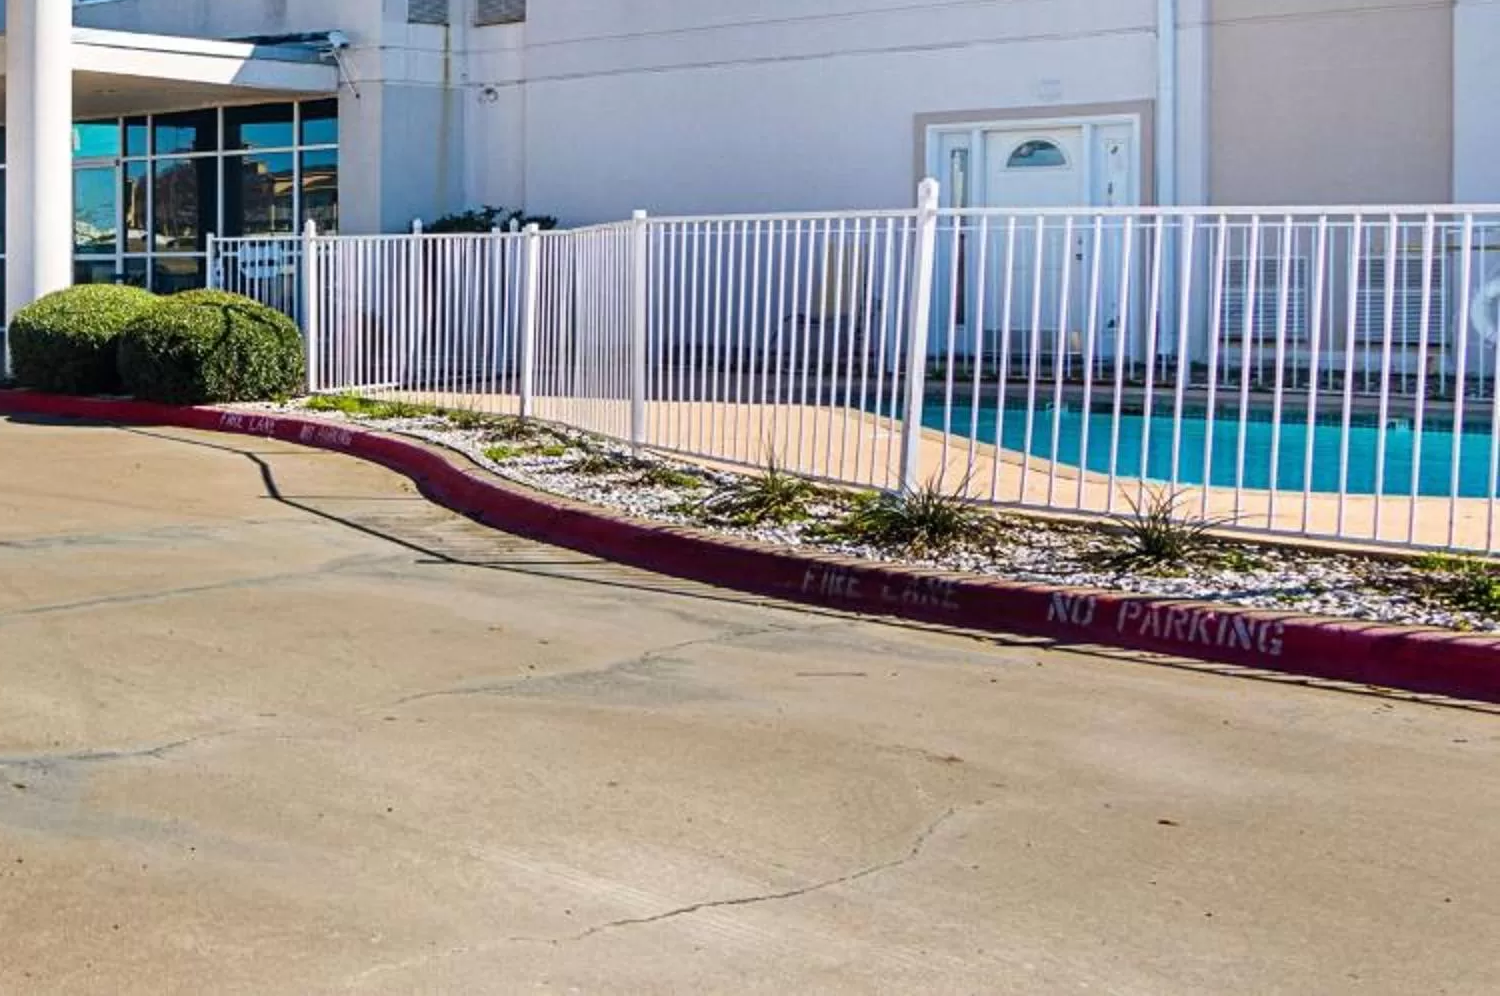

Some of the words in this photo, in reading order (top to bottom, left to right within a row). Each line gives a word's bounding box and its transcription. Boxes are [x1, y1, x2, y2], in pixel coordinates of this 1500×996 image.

[801, 562, 864, 598] FIRE
[1047, 591, 1097, 626] NO
[1116, 600, 1285, 656] PARKING
